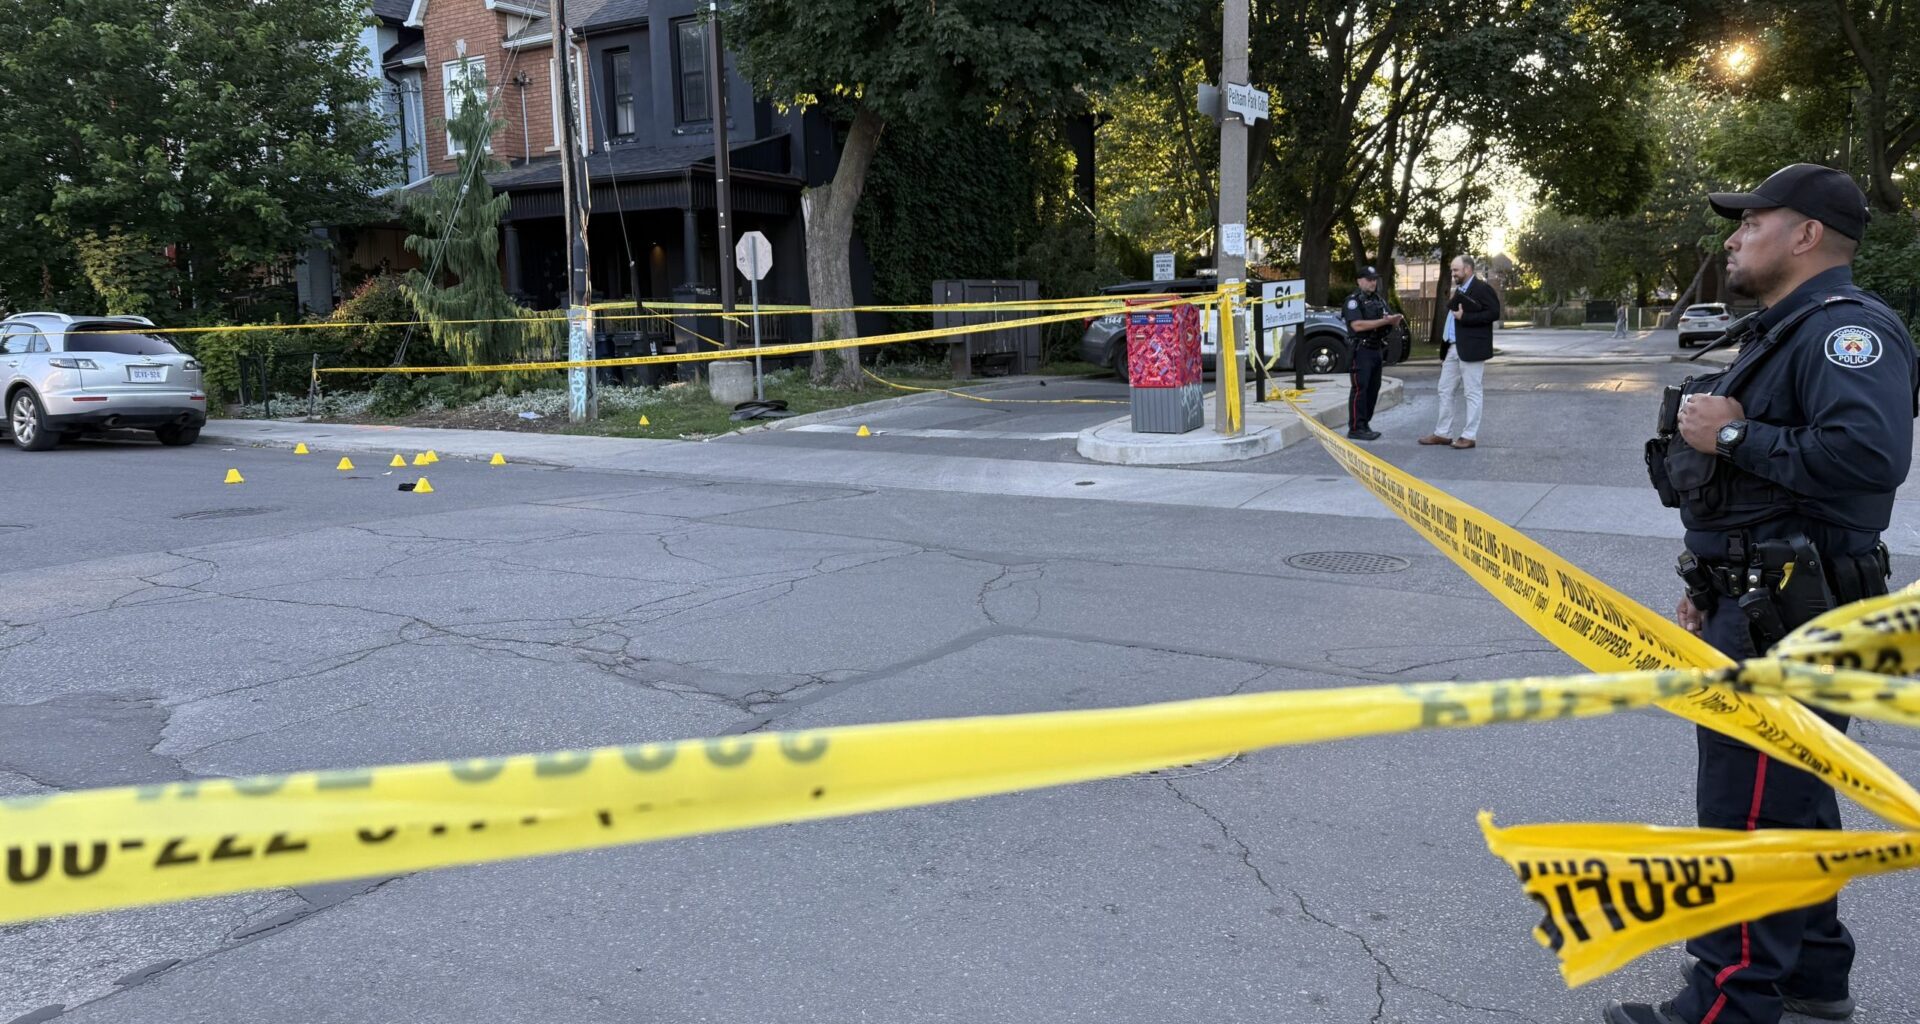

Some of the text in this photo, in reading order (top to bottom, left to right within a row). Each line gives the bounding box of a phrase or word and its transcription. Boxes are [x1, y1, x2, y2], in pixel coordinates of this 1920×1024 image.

[1229, 87, 1247, 107] Pelham
[1248, 90, 1257, 110] Park
[1275, 285, 1291, 310] 61
[1833, 328, 1872, 339] TORONTO
[1838, 355, 1869, 364] POLICE
[1462, 543, 1470, 560] CALL
[1470, 548, 1481, 568] CRIME
[1463, 518, 1549, 588] POLICE LINE- DO NOT CROSS
[1556, 569, 1598, 616] POLICE
[1554, 602, 1572, 625] CALL
[1568, 610, 1594, 638] CRIME
[1588, 624, 1632, 659] STOPPERS-
[1629, 856, 1735, 885] CALL
